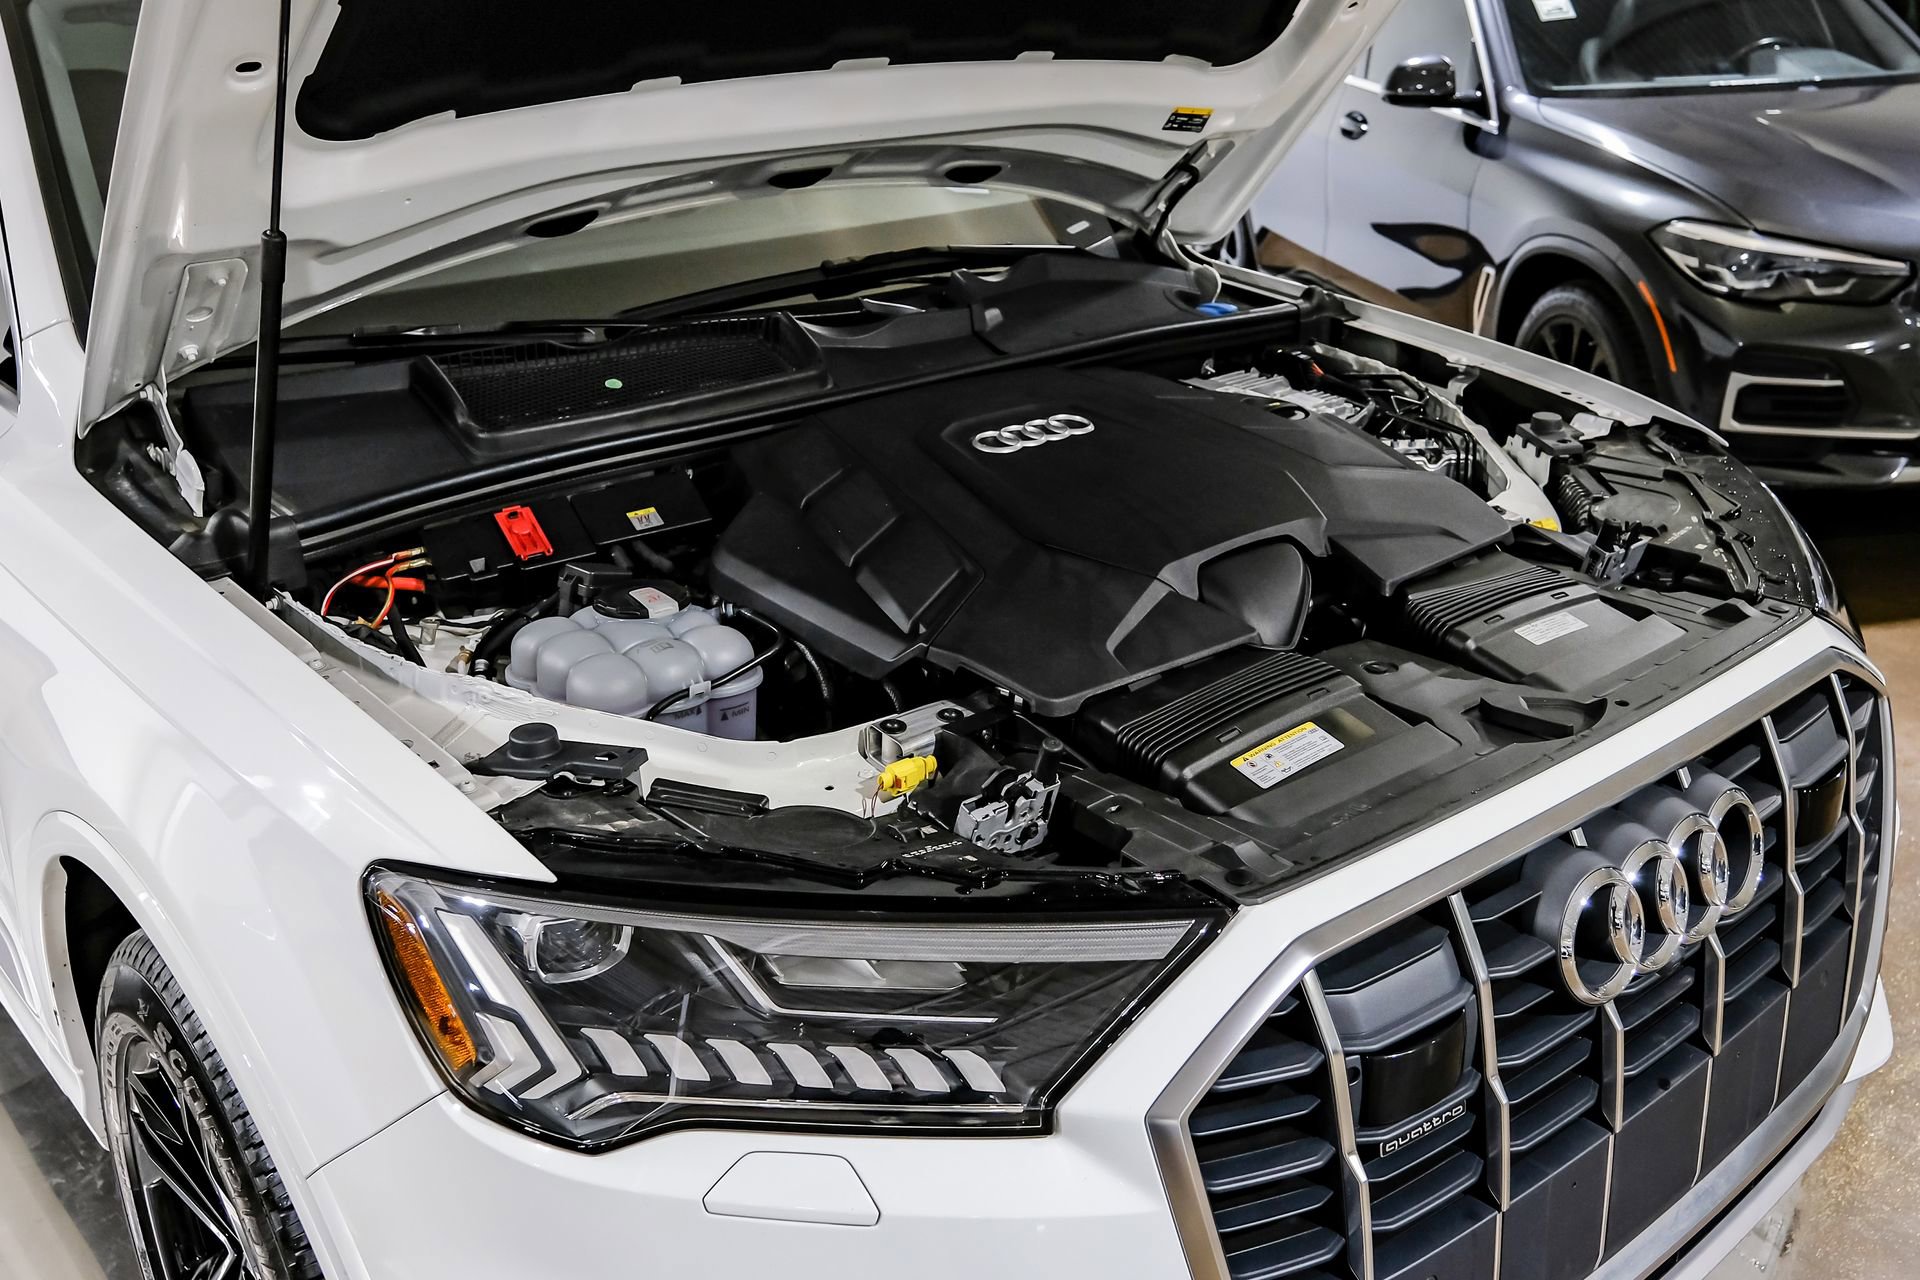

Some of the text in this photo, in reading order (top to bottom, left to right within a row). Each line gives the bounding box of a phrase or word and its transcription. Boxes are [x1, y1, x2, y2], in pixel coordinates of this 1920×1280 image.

[674, 708, 695, 720] MAX
[731, 706, 750, 718] MIN
[1248, 741, 1277, 757] WARNING
[1277, 727, 1308, 743] ATTENTION
[1385, 1105, 1464, 1152] quattro
